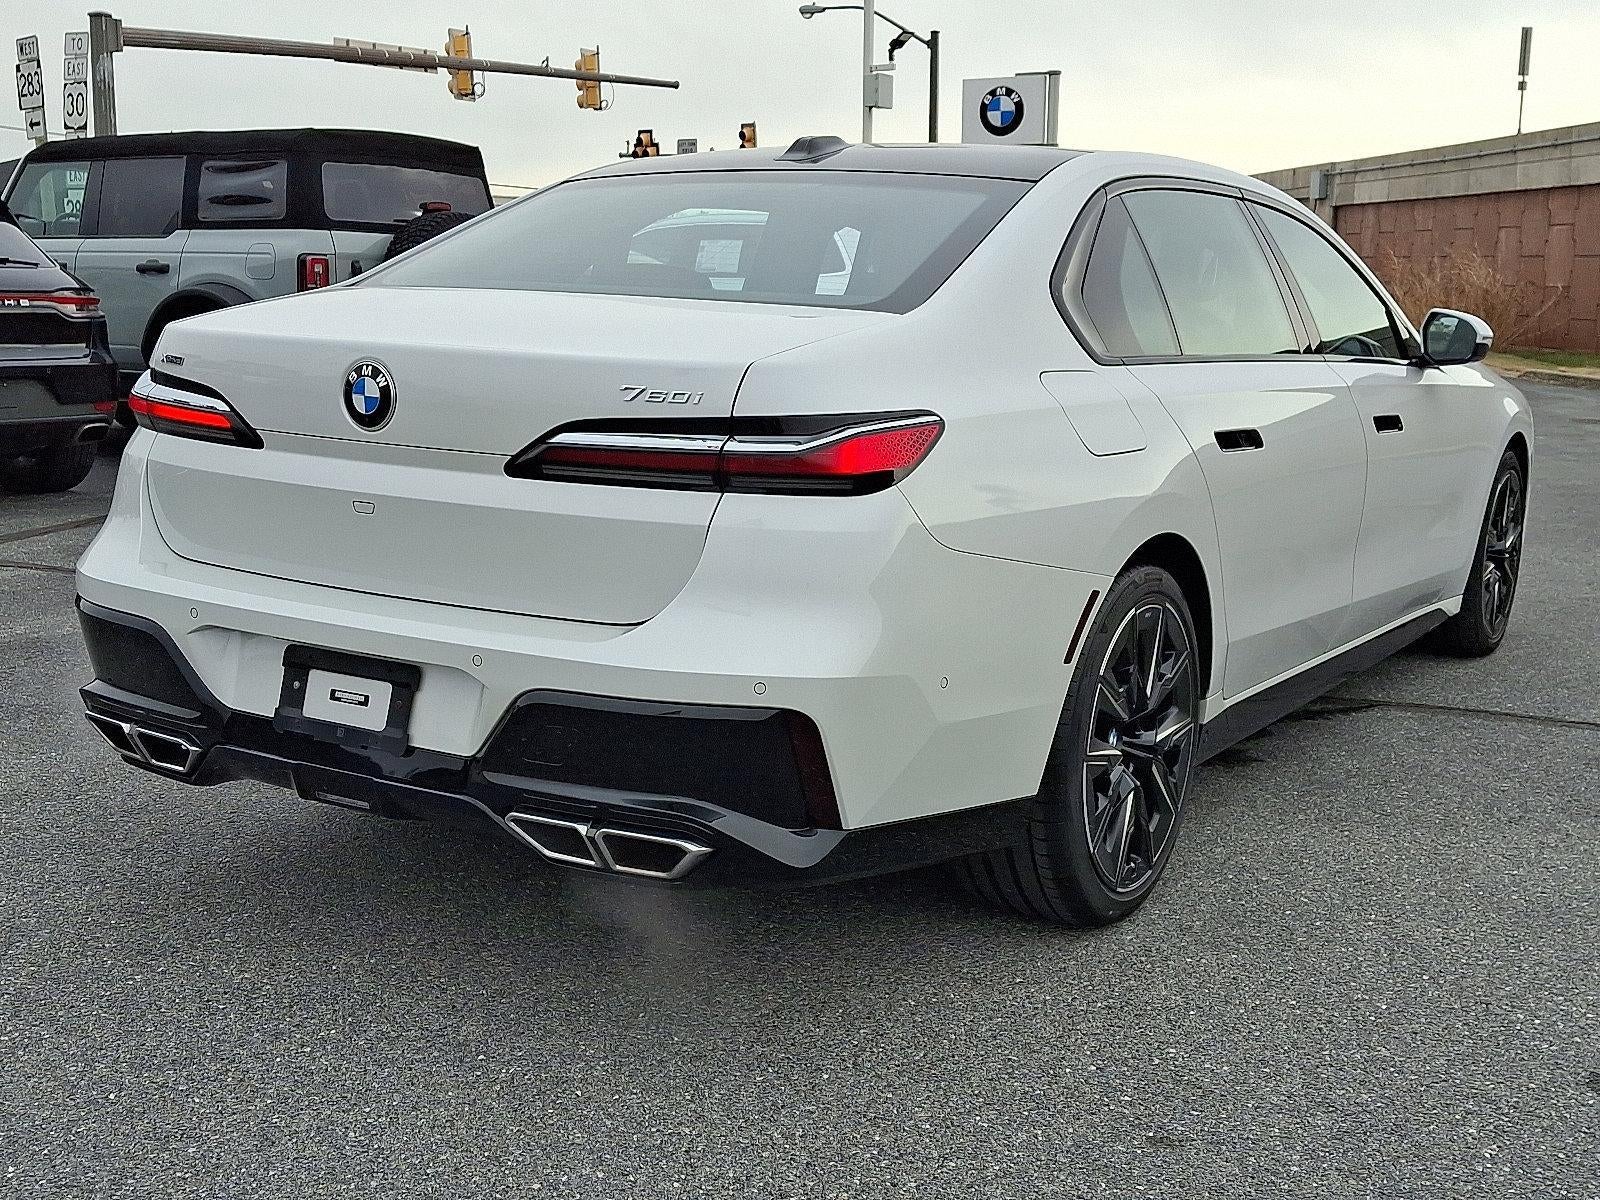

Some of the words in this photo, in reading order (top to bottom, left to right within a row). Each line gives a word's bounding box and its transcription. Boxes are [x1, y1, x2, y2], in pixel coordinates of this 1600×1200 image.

[19, 41, 35, 56] WEST
[71, 37, 83, 50] TO
[67, 61, 85, 76] EAST
[19, 70, 41, 98] 283
[66, 92, 85, 117] 30
[983, 87, 1021, 105] BMW
[348, 364, 388, 388] BMW
[619, 384, 705, 405] 760i
